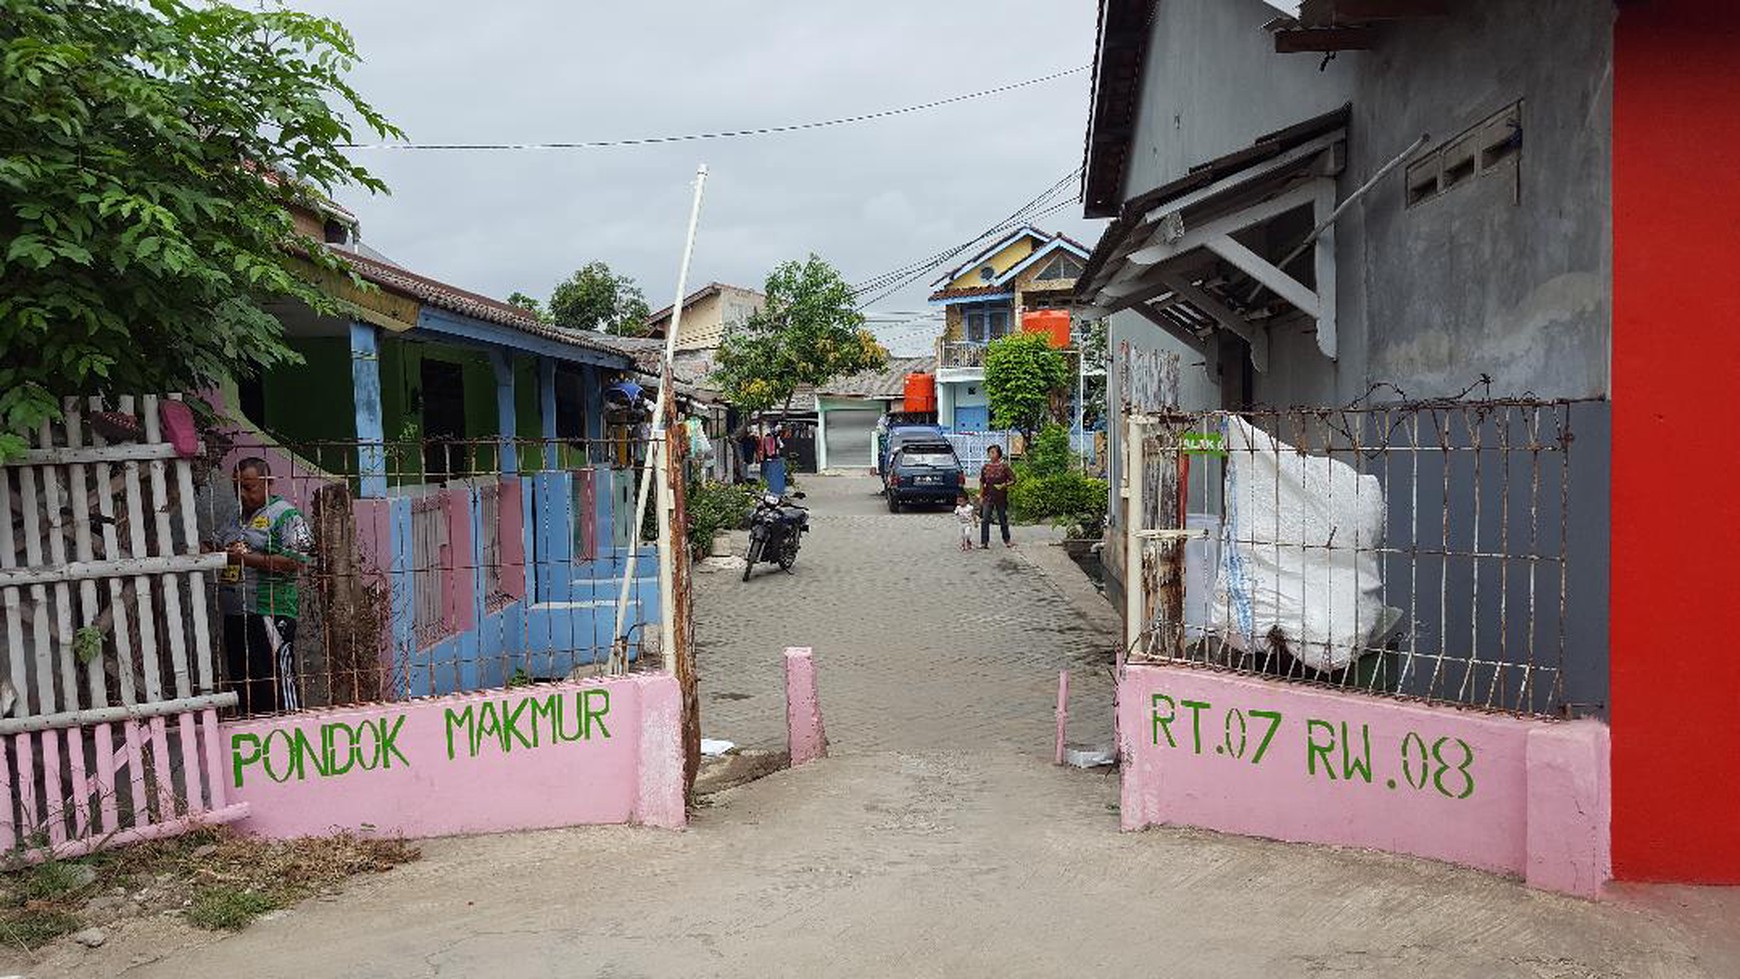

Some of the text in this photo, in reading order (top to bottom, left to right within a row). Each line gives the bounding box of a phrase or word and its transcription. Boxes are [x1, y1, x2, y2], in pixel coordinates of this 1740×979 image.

[231, 688, 611, 788] PONDOK MAKMUR
[1151, 693, 1475, 799] RT.07 RW.08
